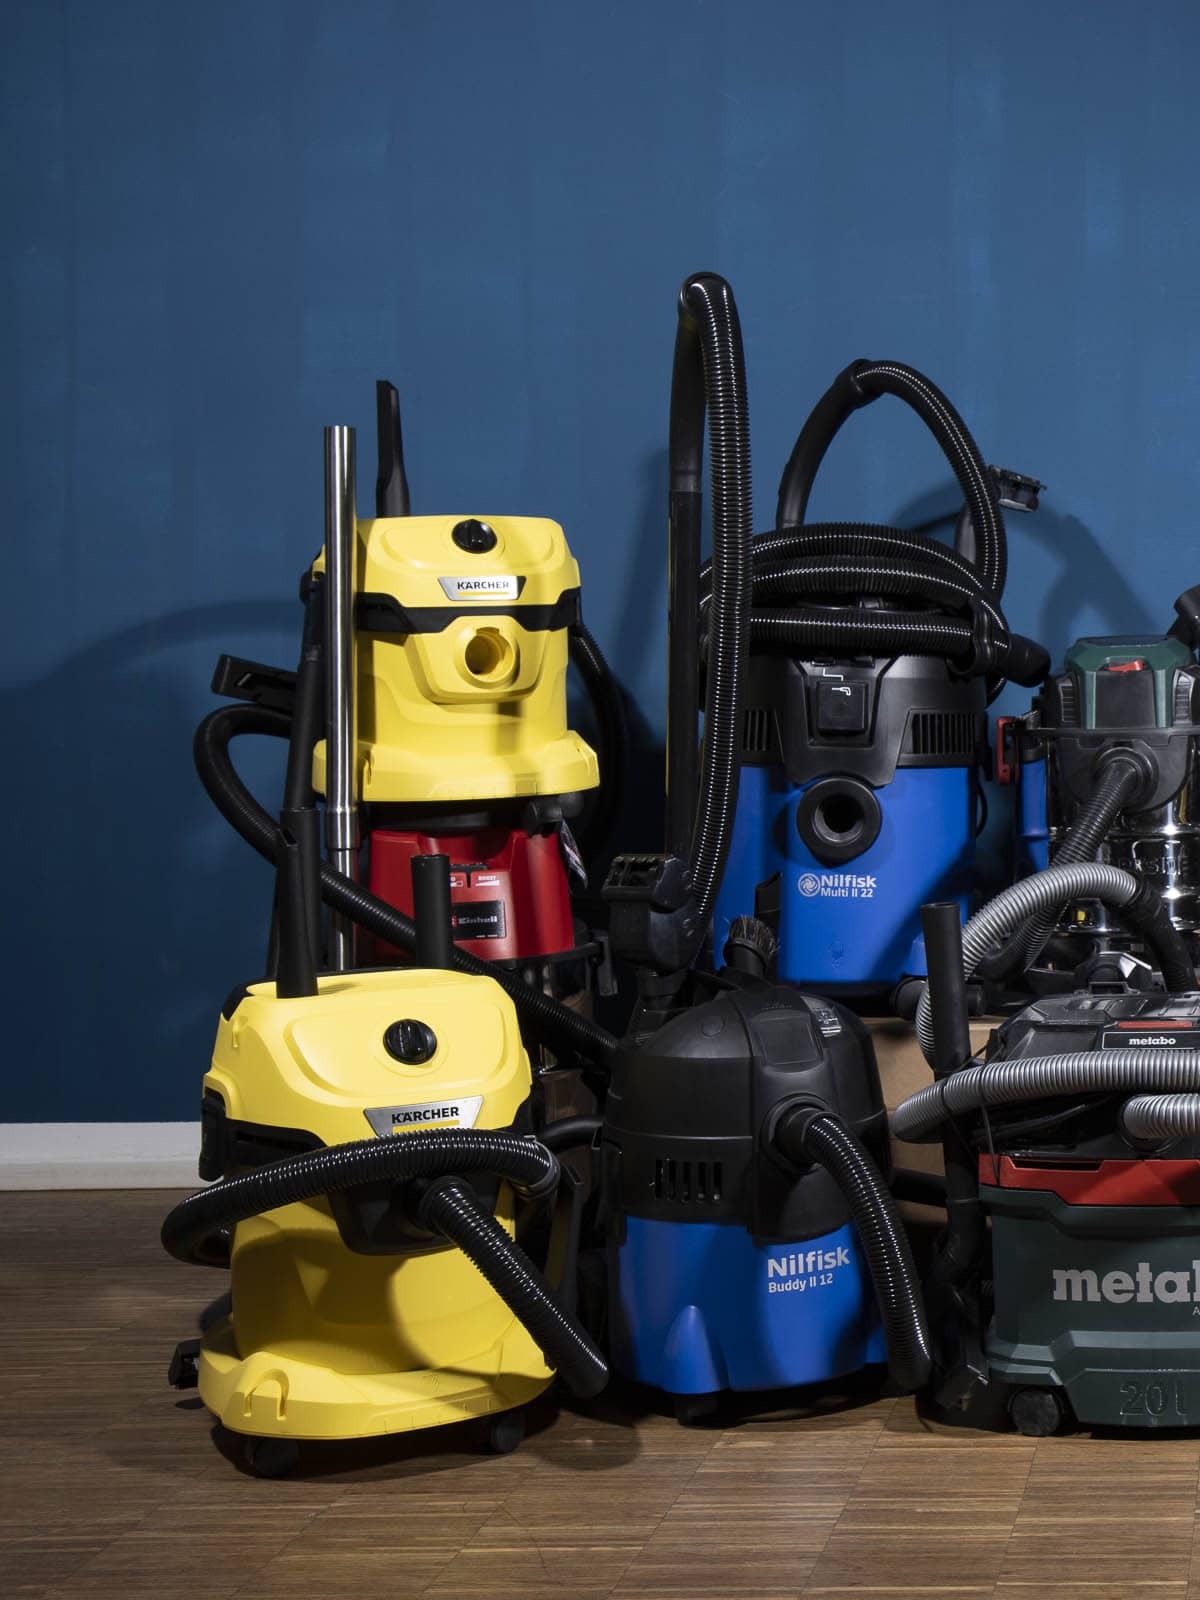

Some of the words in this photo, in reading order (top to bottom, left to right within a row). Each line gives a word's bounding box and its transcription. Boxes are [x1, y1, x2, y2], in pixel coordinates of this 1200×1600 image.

[821, 874, 877, 888] Nilfisk
[821, 887, 849, 897] Multi
[860, 888, 873, 897] 22
[1128, 1037, 1176, 1046] metabo
[392, 1107, 459, 1124] KÄRCHER
[767, 1246, 850, 1278] Nilfisk
[768, 1278, 807, 1294] Buddy
[819, 1272, 833, 1286] 12
